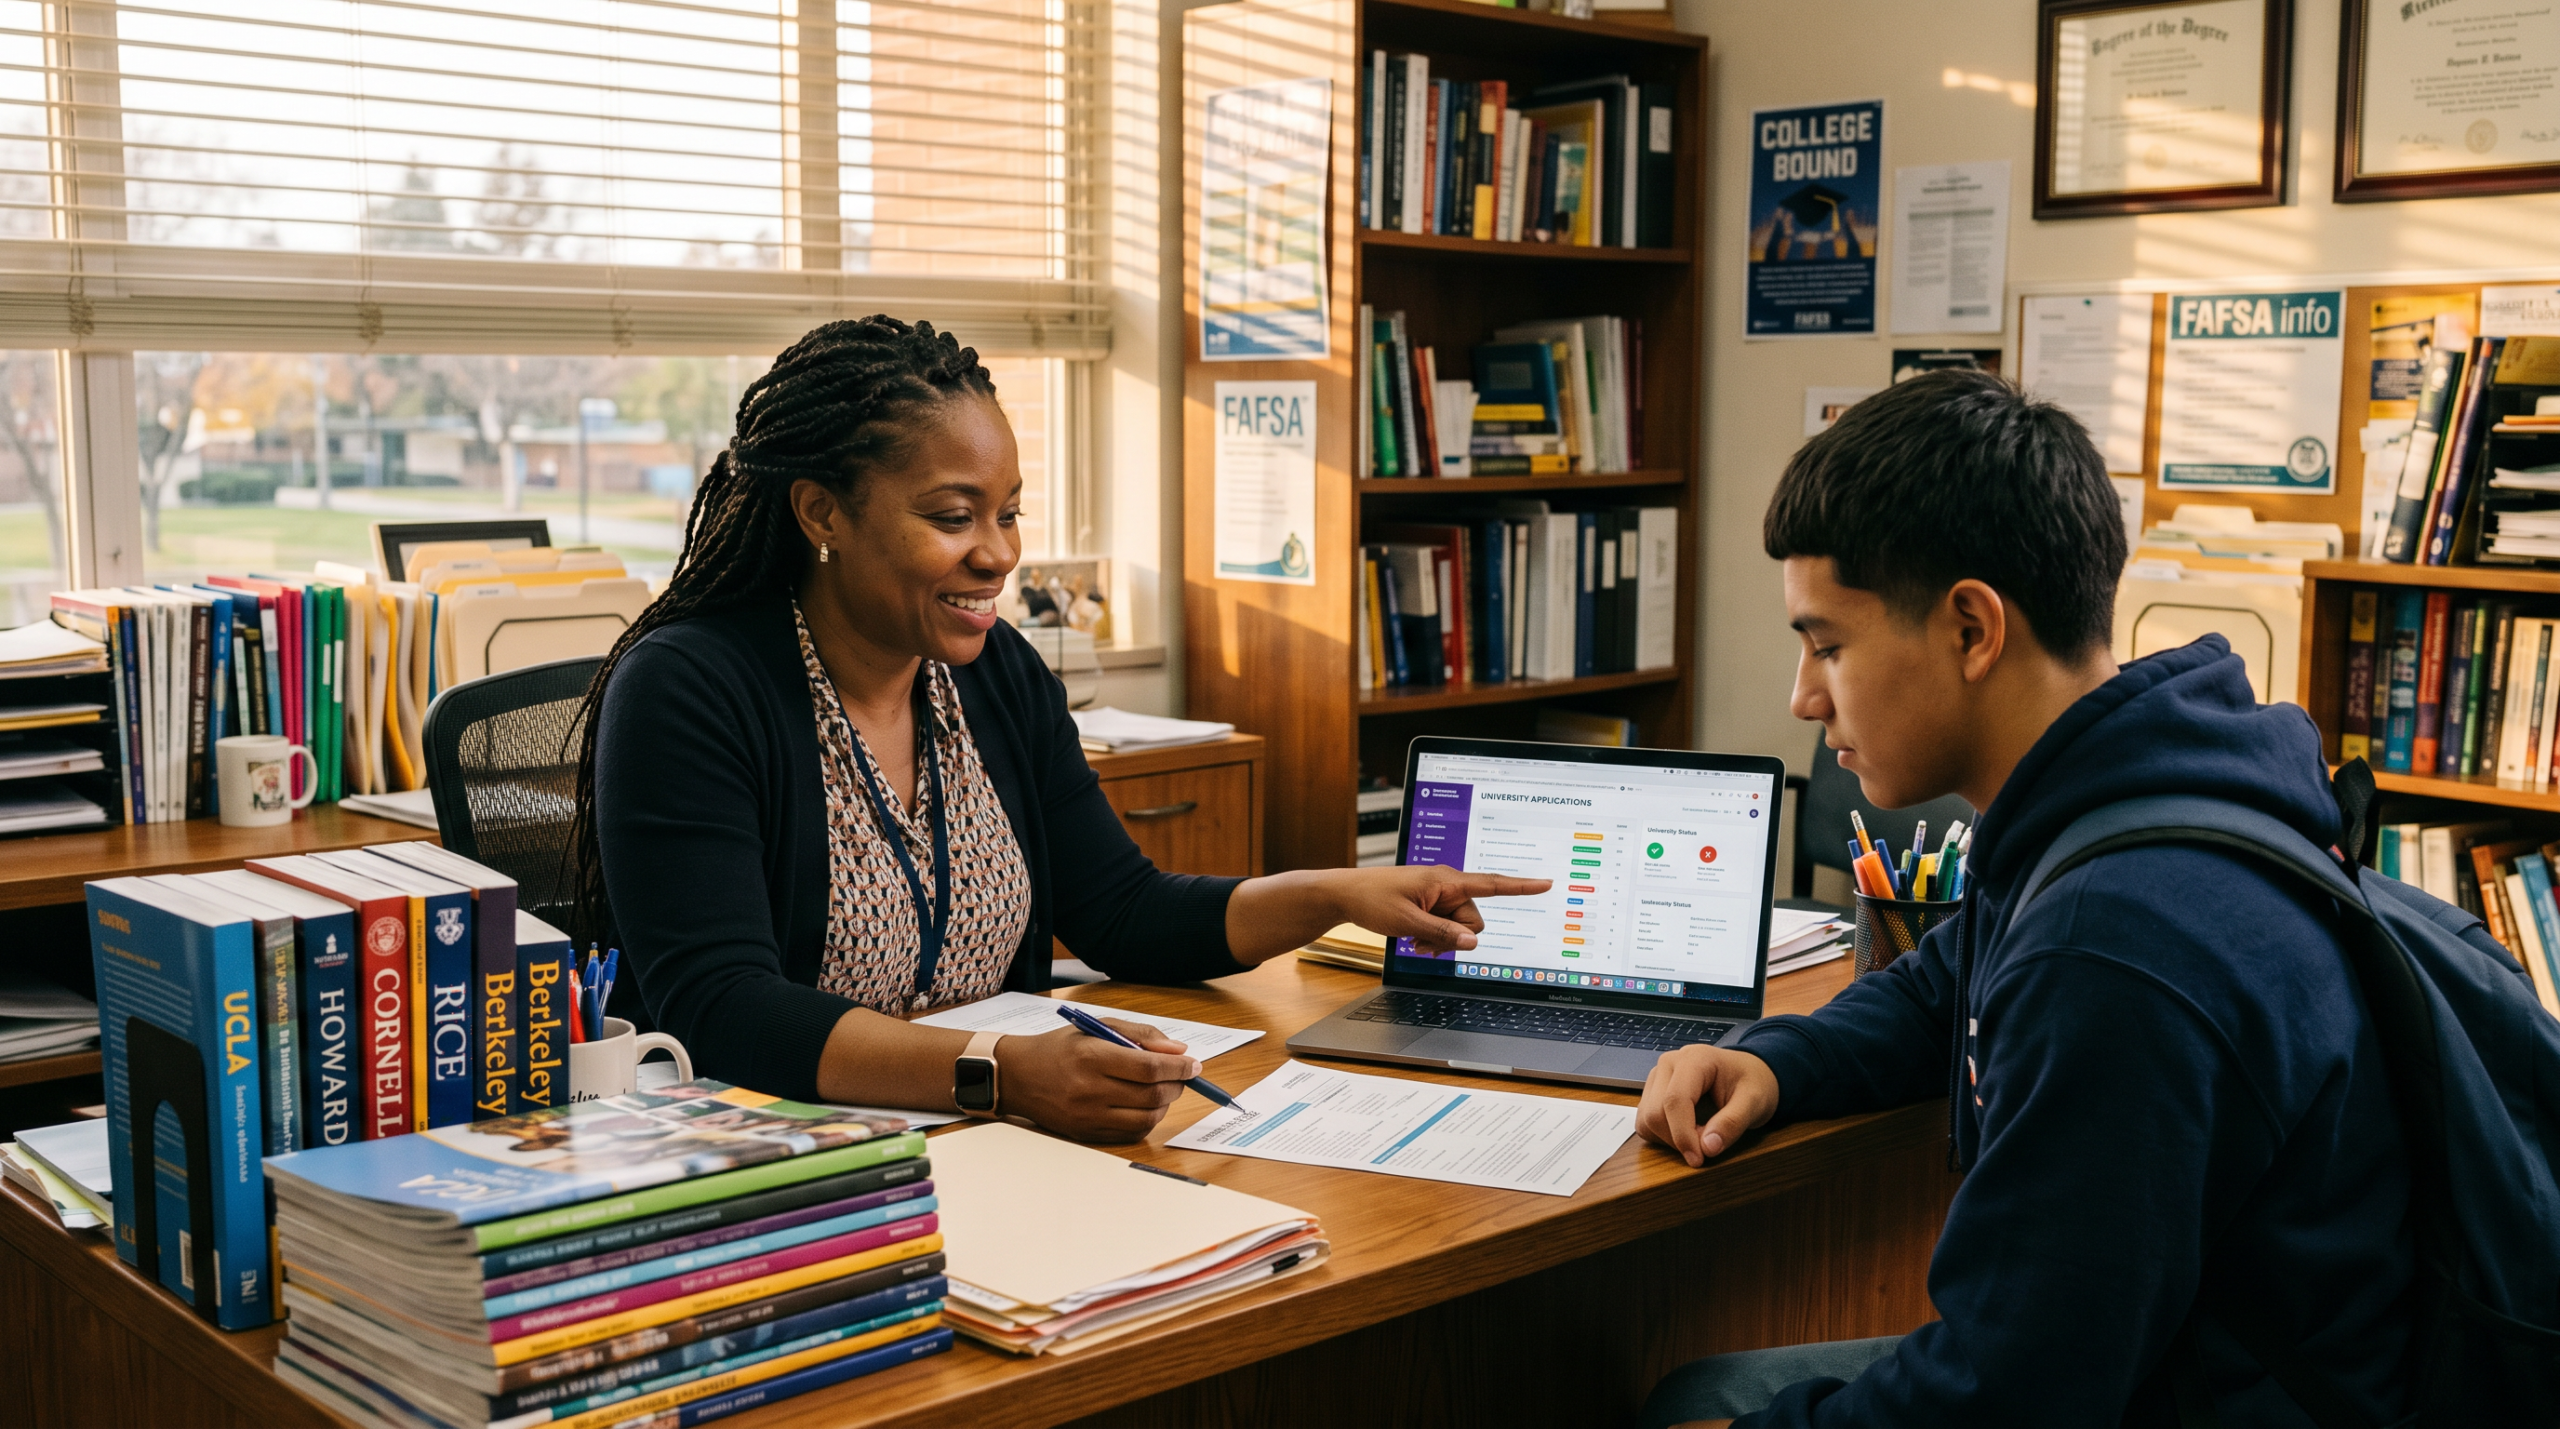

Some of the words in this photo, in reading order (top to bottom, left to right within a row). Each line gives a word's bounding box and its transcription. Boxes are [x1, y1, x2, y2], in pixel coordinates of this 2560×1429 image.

[2139, 22, 2153, 38] of
[2156, 20, 2176, 37] the
[1760, 111, 1874, 151] COLLEGE
[1772, 147, 1858, 182] BOUND
[2179, 299, 2274, 336] FAFSA
[2280, 298, 2332, 334] info
[1222, 395, 1304, 437] FAFSA
[1480, 792, 1529, 805] UNIVERSITY
[1530, 794, 1593, 807] APPLICATIONS
[223, 991, 252, 1076] UCLA
[373, 967, 403, 1138] CORNELL
[434, 982, 466, 1081] RICE
[477, 969, 516, 1116] Berkeley
[521, 959, 562, 1107] Berkeley
[320, 988, 349, 1145] HOWARD
